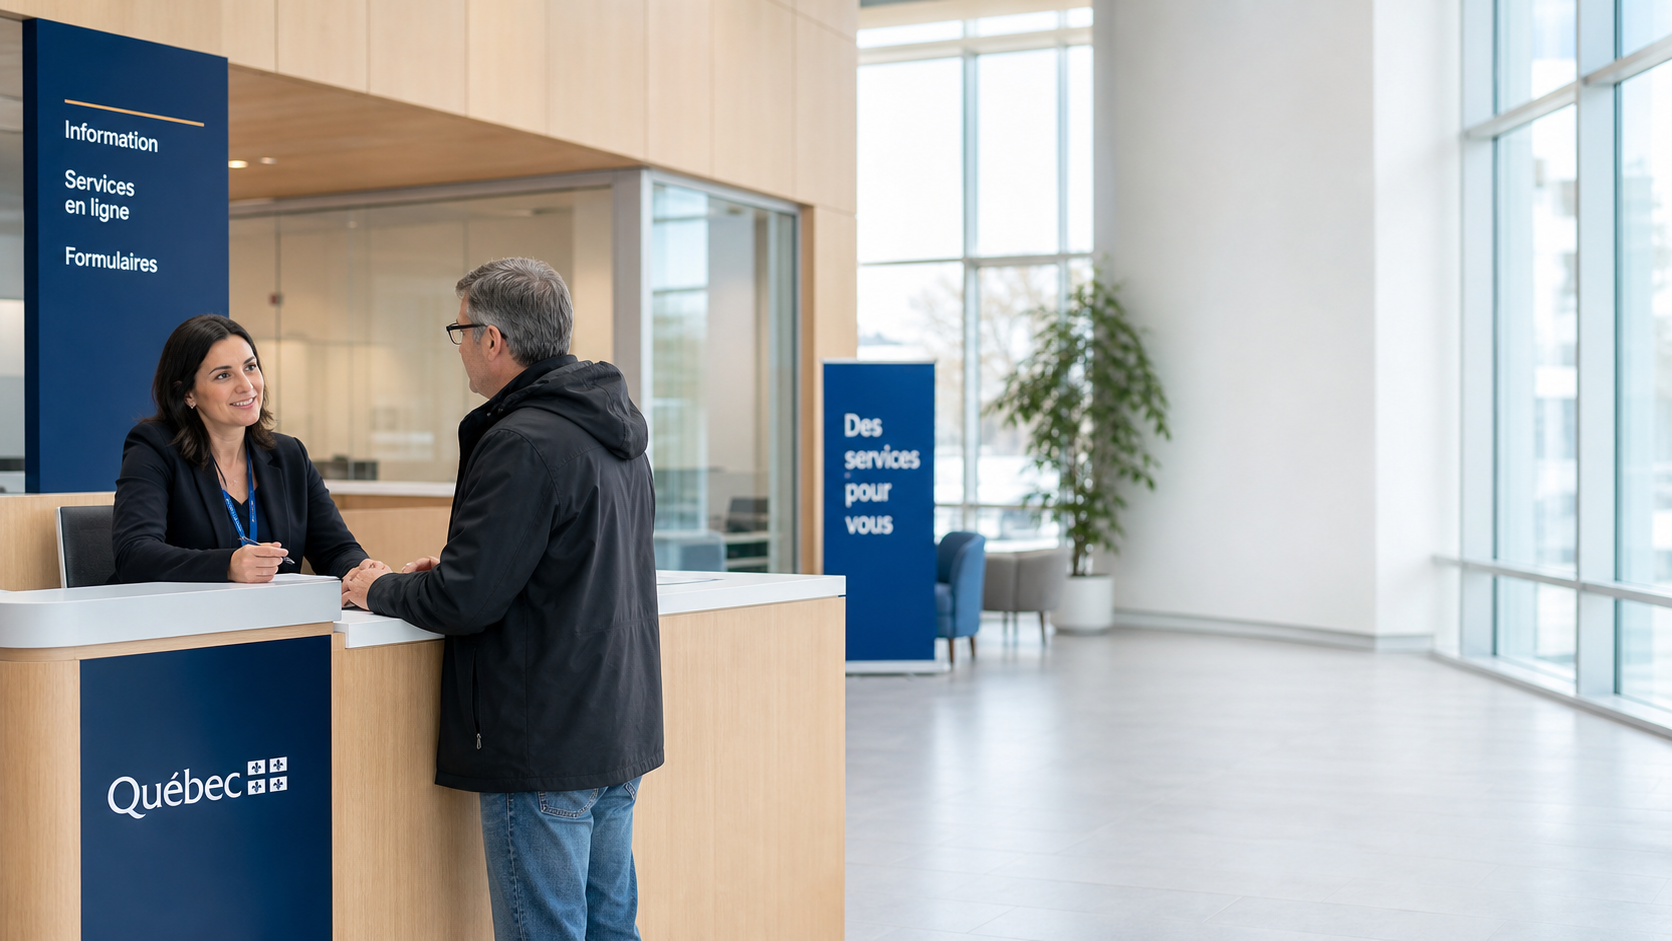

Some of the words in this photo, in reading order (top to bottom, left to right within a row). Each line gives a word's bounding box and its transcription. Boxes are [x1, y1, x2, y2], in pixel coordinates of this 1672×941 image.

[65, 120, 159, 153] Information
[65, 169, 135, 197] Services
[65, 199, 86, 215] en
[90, 197, 130, 223] ligne
[65, 246, 158, 273] Formulaires
[844, 413, 883, 438] Des
[844, 444, 921, 470] services
[845, 482, 892, 508] pour
[845, 515, 894, 535] vous
[107, 768, 242, 820] Québec
